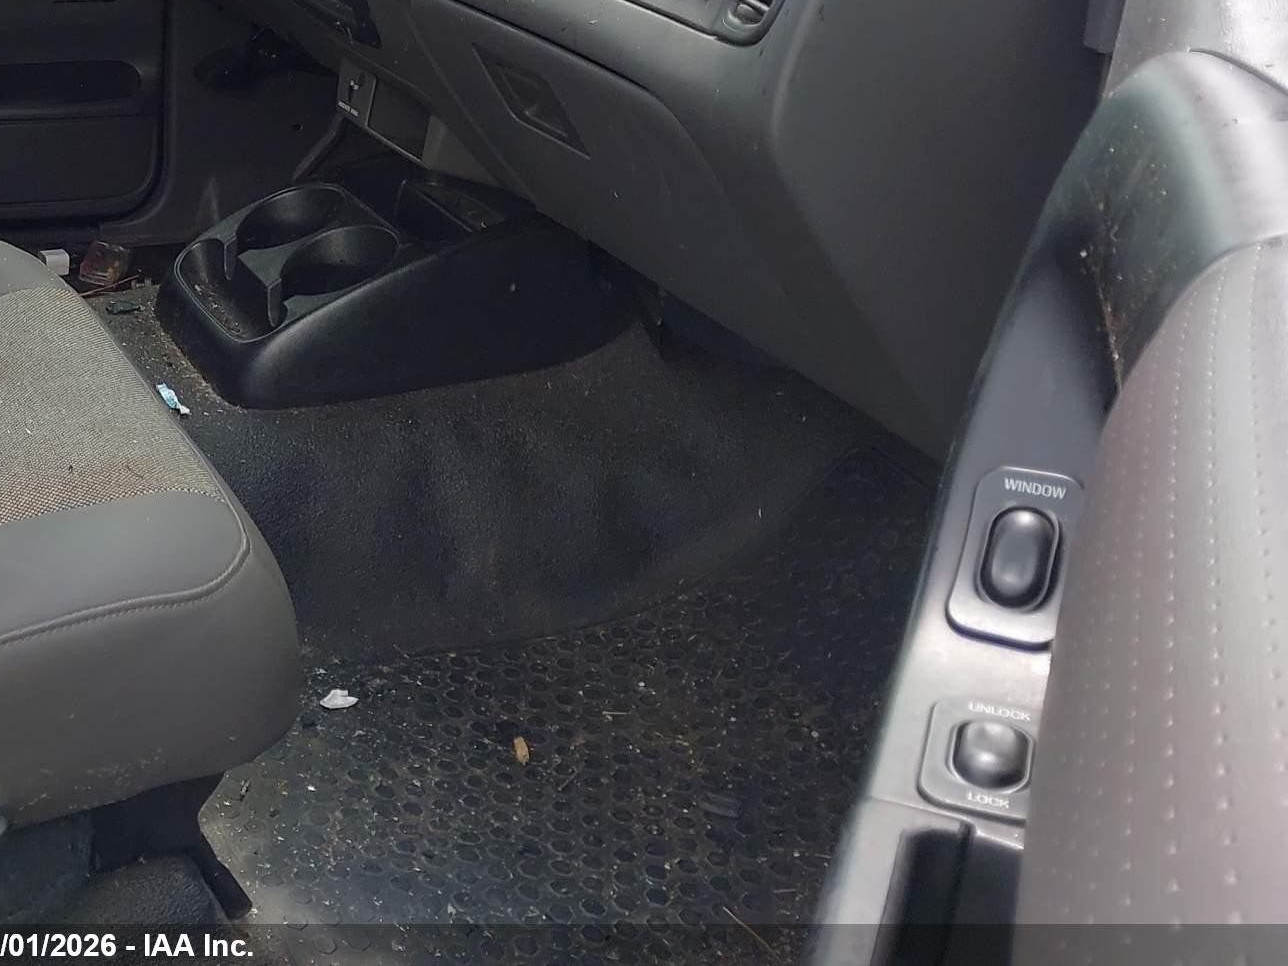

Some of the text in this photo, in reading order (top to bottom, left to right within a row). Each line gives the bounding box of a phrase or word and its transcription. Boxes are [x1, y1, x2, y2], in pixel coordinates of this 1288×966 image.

[1004, 477, 1067, 500] WINDOW
[968, 701, 1031, 722] UNLOCK
[966, 791, 1010, 809] LOCK
